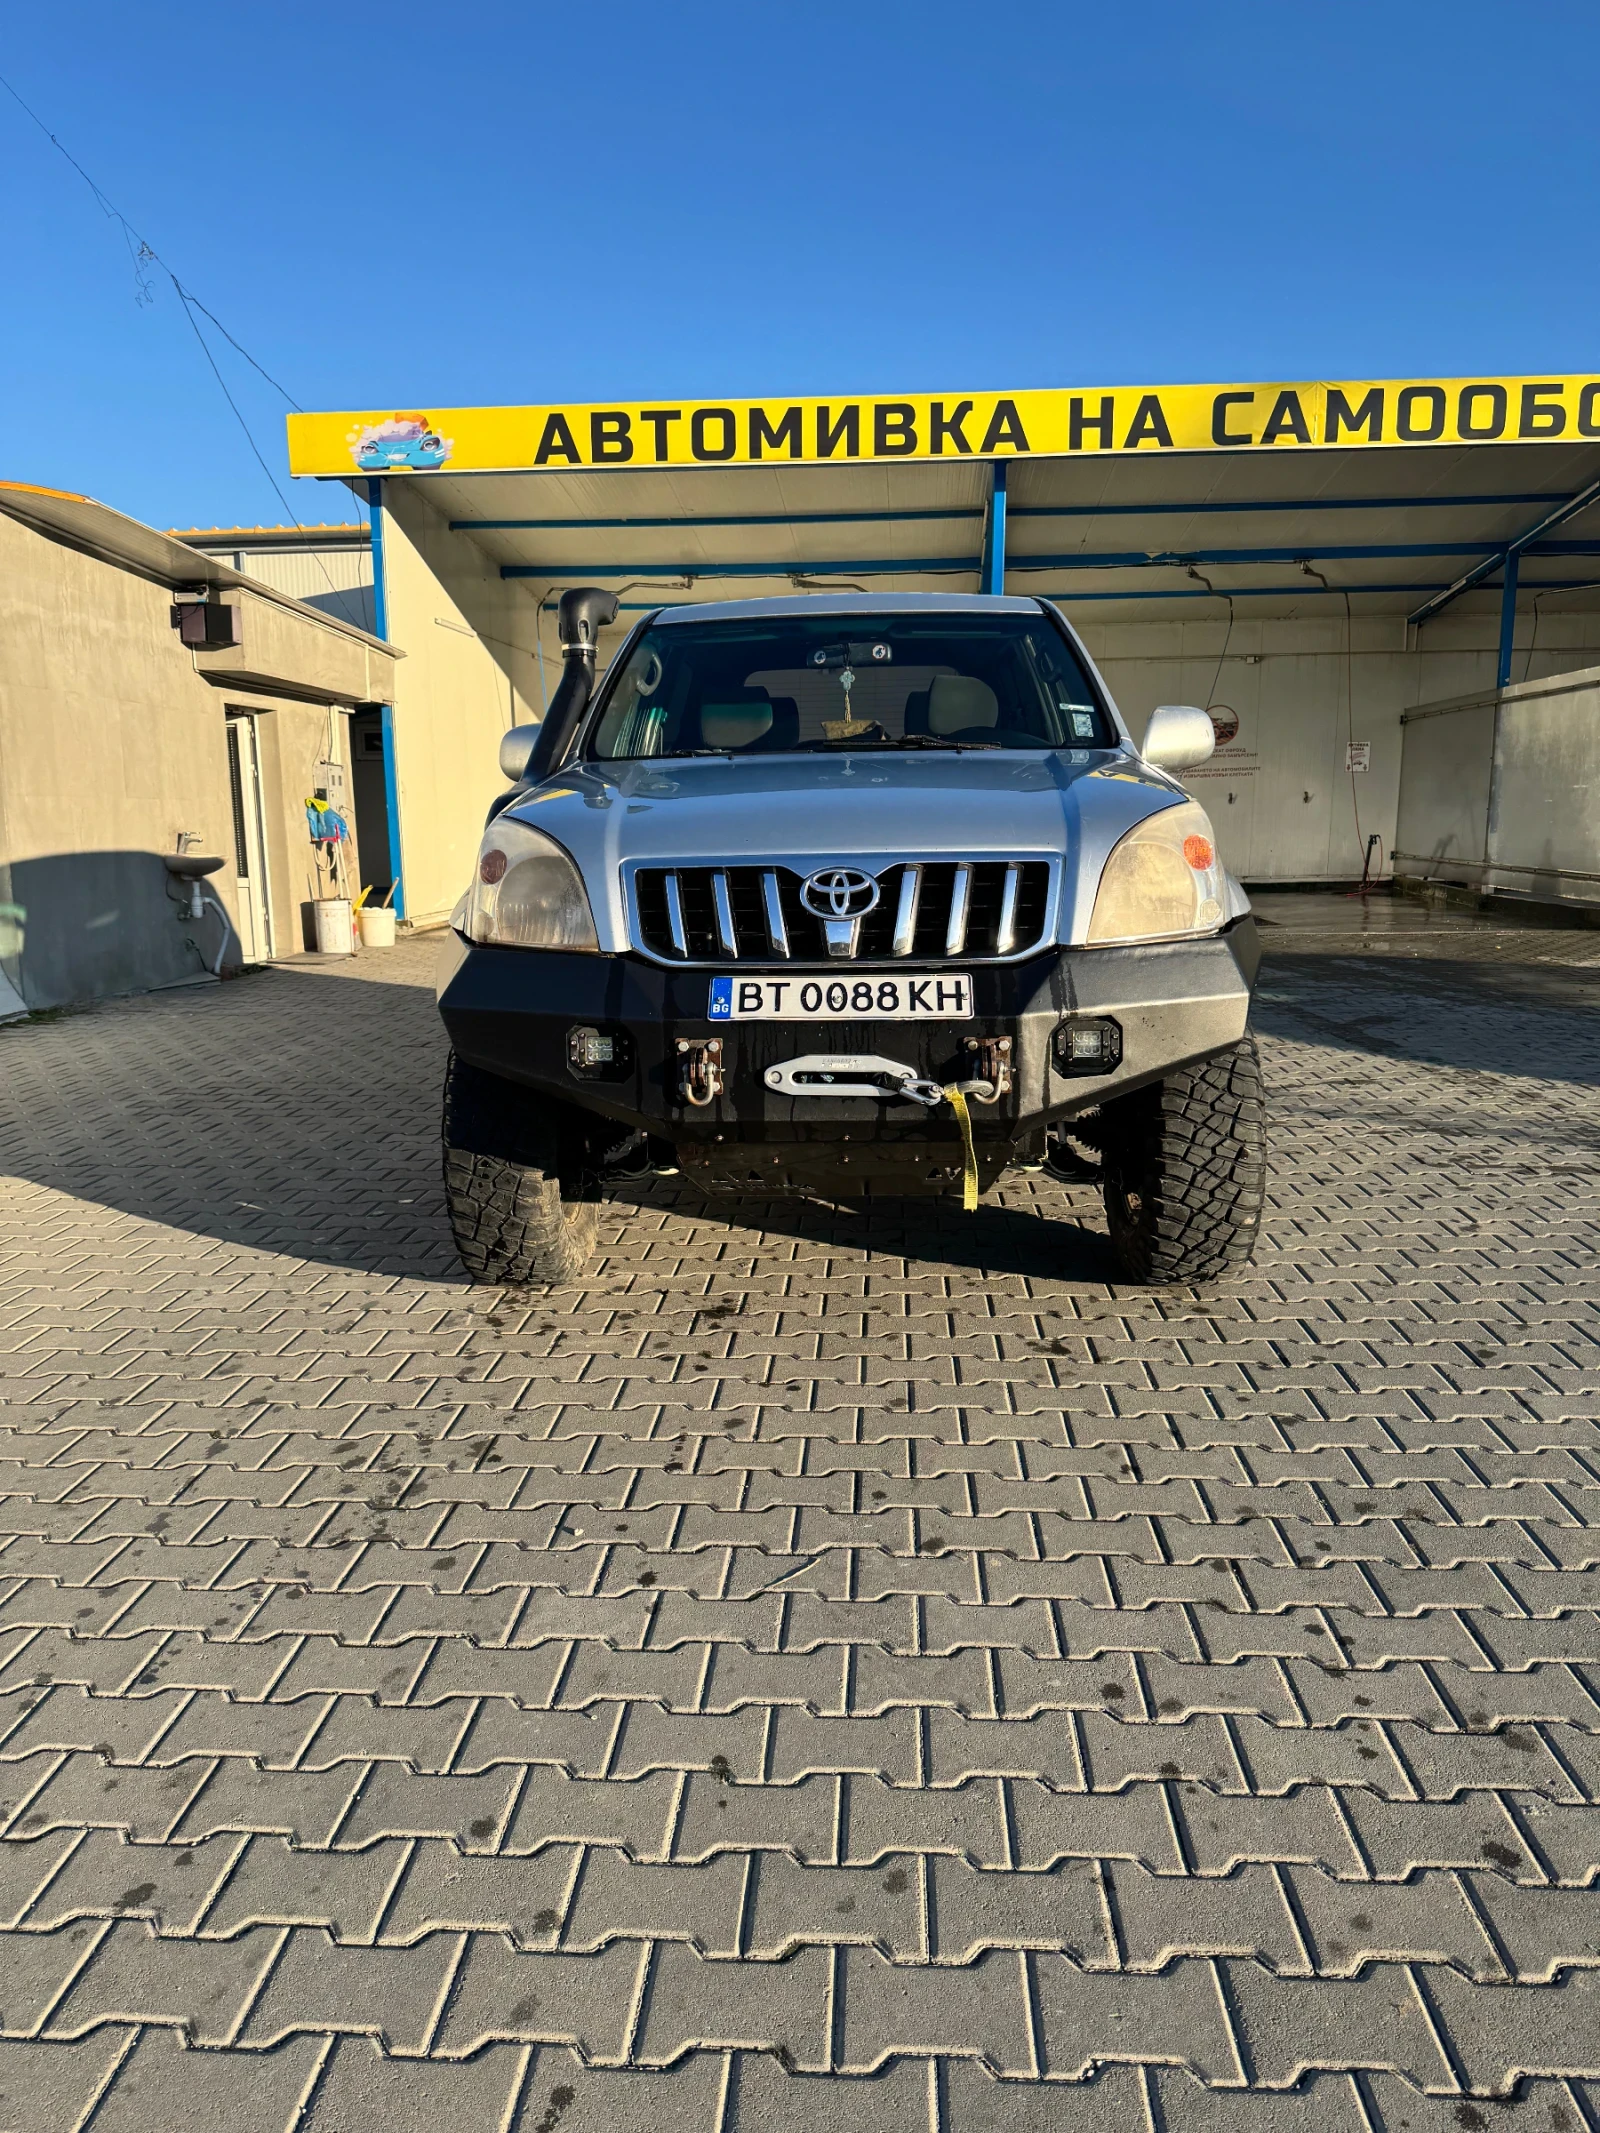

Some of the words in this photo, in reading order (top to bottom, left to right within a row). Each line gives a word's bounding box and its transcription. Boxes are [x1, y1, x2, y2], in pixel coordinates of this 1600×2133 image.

[534, 399, 1030, 465] АВТОМИВКА
[1068, 394, 1174, 450] НА
[712, 1003, 729, 1013] BG
[738, 982, 791, 1012] BT
[800, 981, 899, 1012] 0088
[909, 980, 963, 1011] KH
